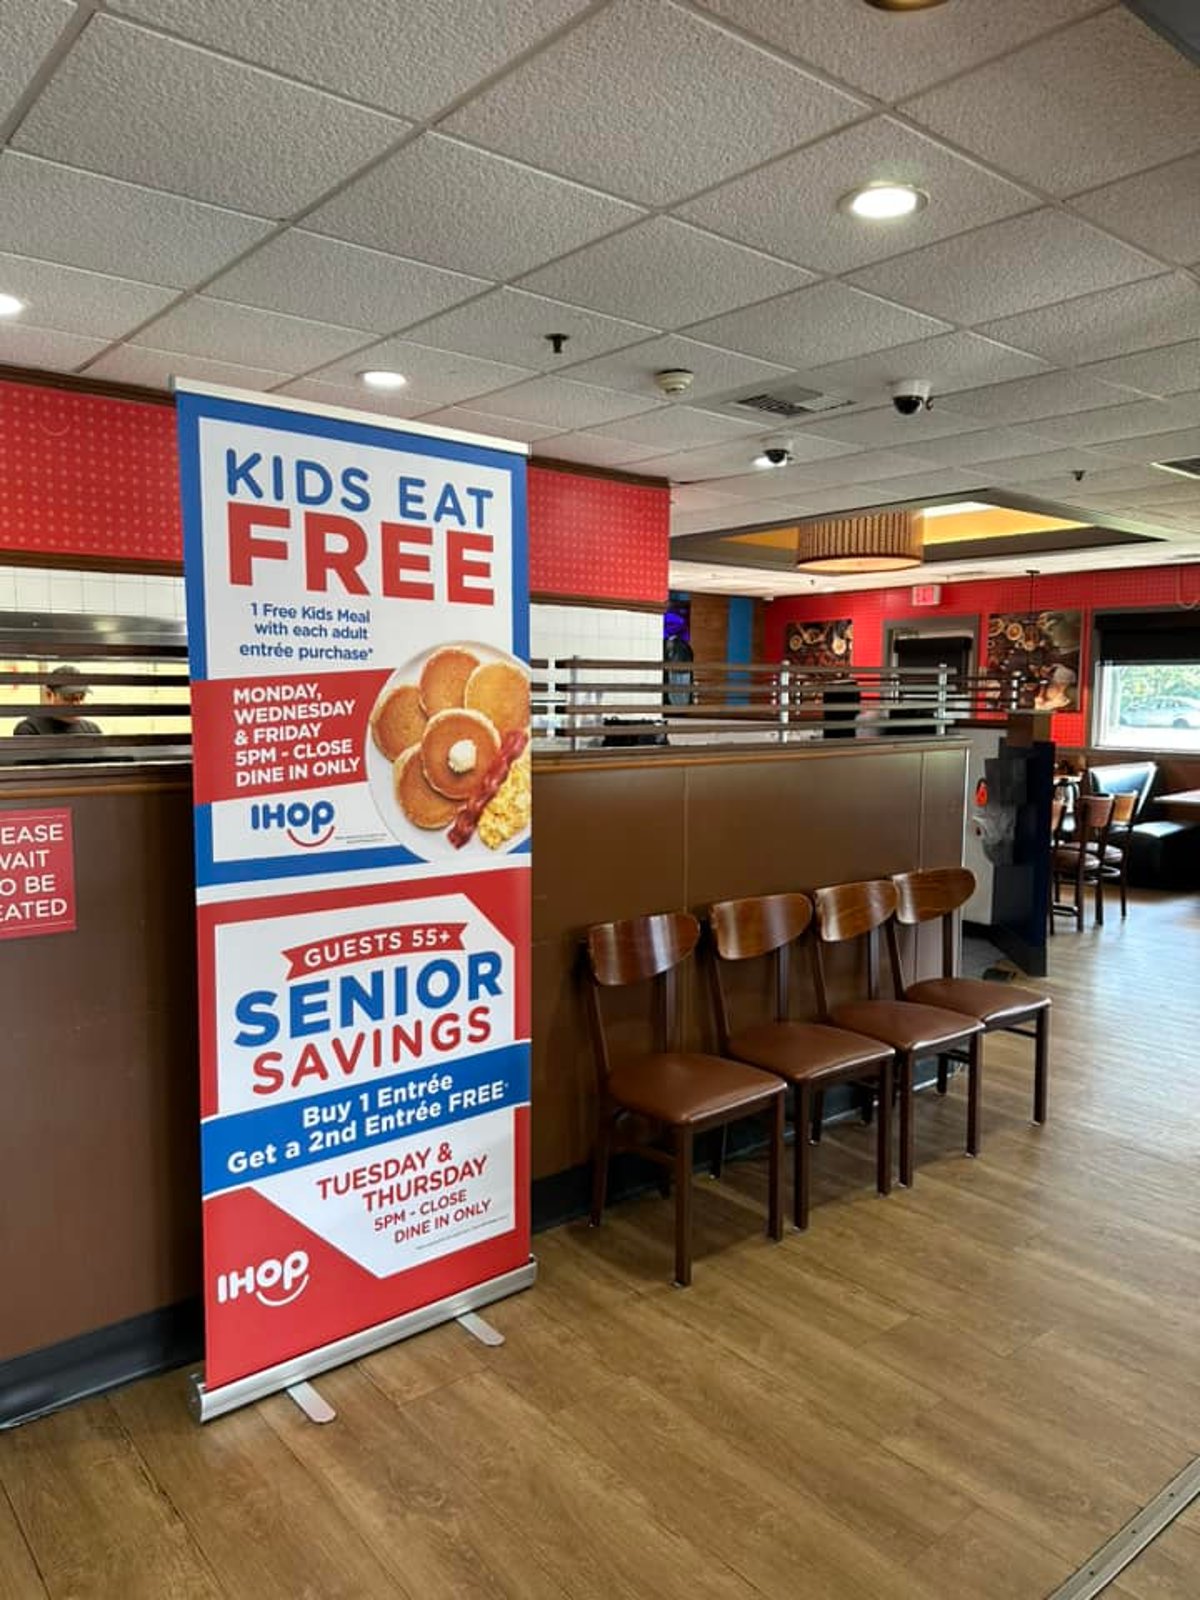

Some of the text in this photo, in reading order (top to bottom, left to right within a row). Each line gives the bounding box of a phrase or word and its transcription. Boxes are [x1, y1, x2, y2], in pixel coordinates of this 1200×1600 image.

[226, 448, 493, 528] KIDS EAT
[227, 501, 494, 606] FREE
[250, 602, 370, 623] 1 Free Kids Meal
[254, 622, 368, 639] with each adult
[239, 643, 293, 657] entrée
[233, 683, 322, 705] MONDAY,
[233, 700, 356, 725] WEDNESDAY
[234, 723, 322, 746] & FRIDAY
[235, 748, 276, 767] 5PM
[293, 739, 353, 759] CLOSE
[236, 757, 361, 788] DINE IN ONLY
[25, 874, 56, 894] BE
[0, 898, 67, 921] ATED
[303, 929, 451, 968] GUESTS 55+
[234, 951, 503, 1047] SENIOR
[252, 1006, 492, 1096] SAVINGS
[302, 1073, 453, 1129] Buy 1 Entrée
[228, 1146, 277, 1174] Get
[285, 1144, 301, 1158] a
[308, 1124, 357, 1153] 2nd
[365, 1101, 442, 1136] Entrée
[317, 1142, 453, 1200] TUESDAY &
[362, 1155, 488, 1212] THURSDAY
[374, 1213, 406, 1232] 5PM
[419, 1189, 467, 1214] CLOSE
[394, 1221, 430, 1244] DINE
[434, 1213, 449, 1229] IN
[453, 1199, 493, 1222] ONLY
